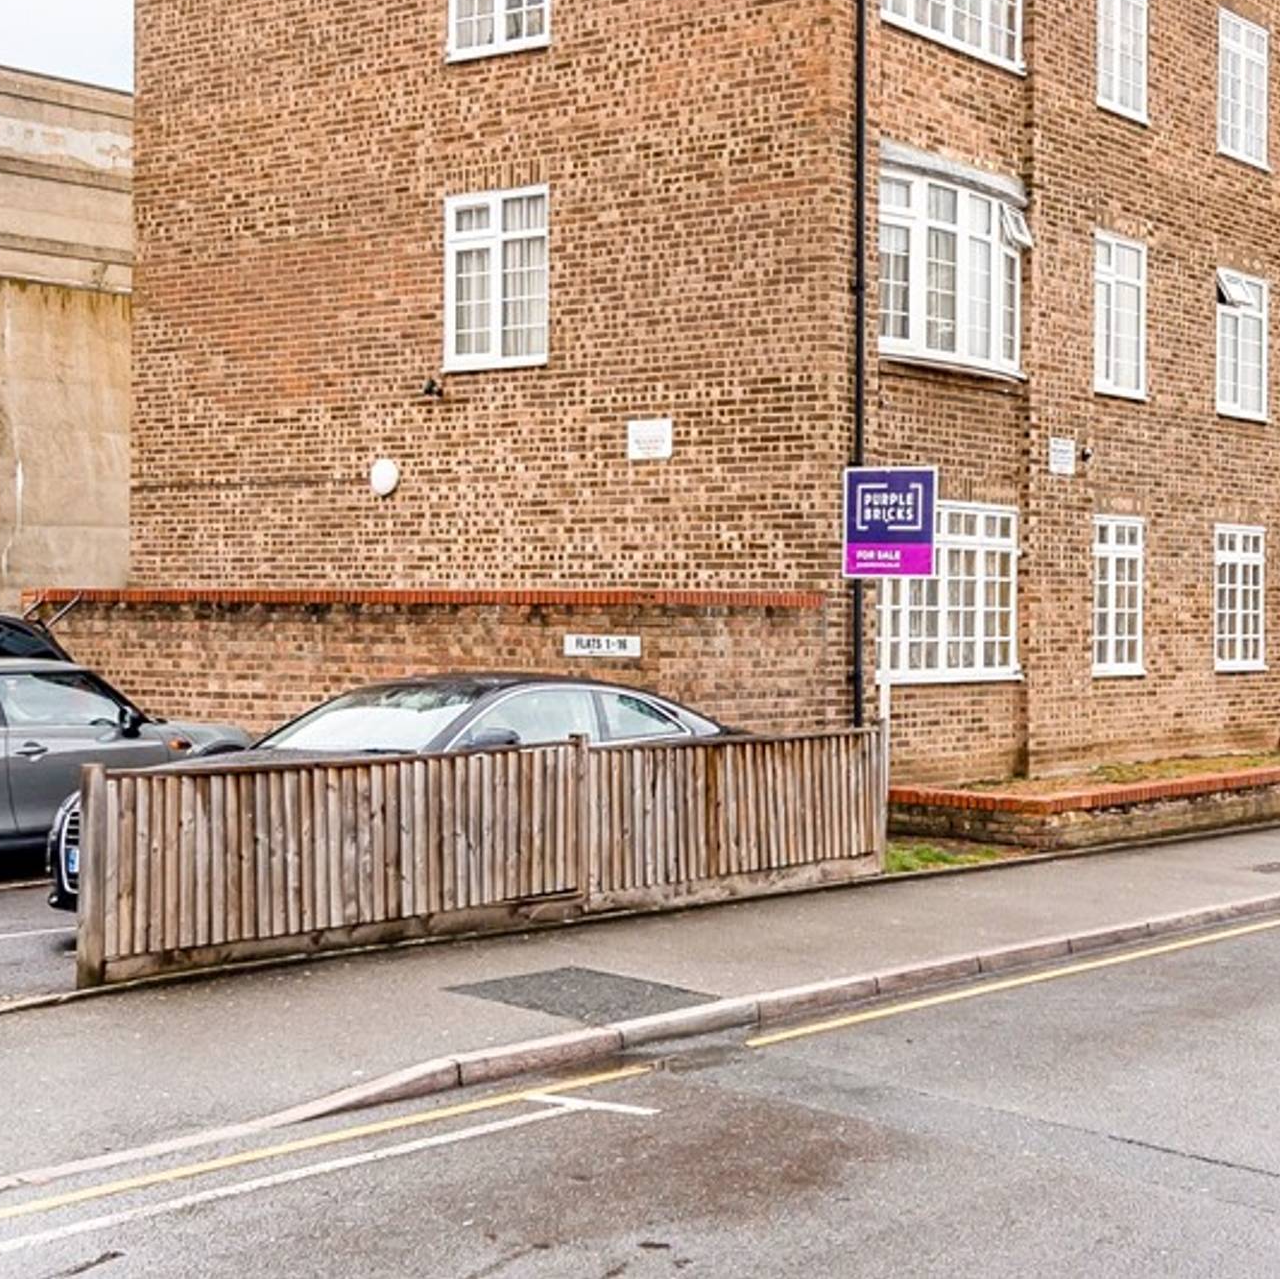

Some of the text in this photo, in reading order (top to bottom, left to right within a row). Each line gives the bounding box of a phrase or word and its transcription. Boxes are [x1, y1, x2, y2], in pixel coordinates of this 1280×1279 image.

[863, 492, 914, 506] PURPLE
[863, 507, 914, 521] BRICKS
[856, 550, 901, 560] FOR SALE
[575, 637, 602, 650] FLATS
